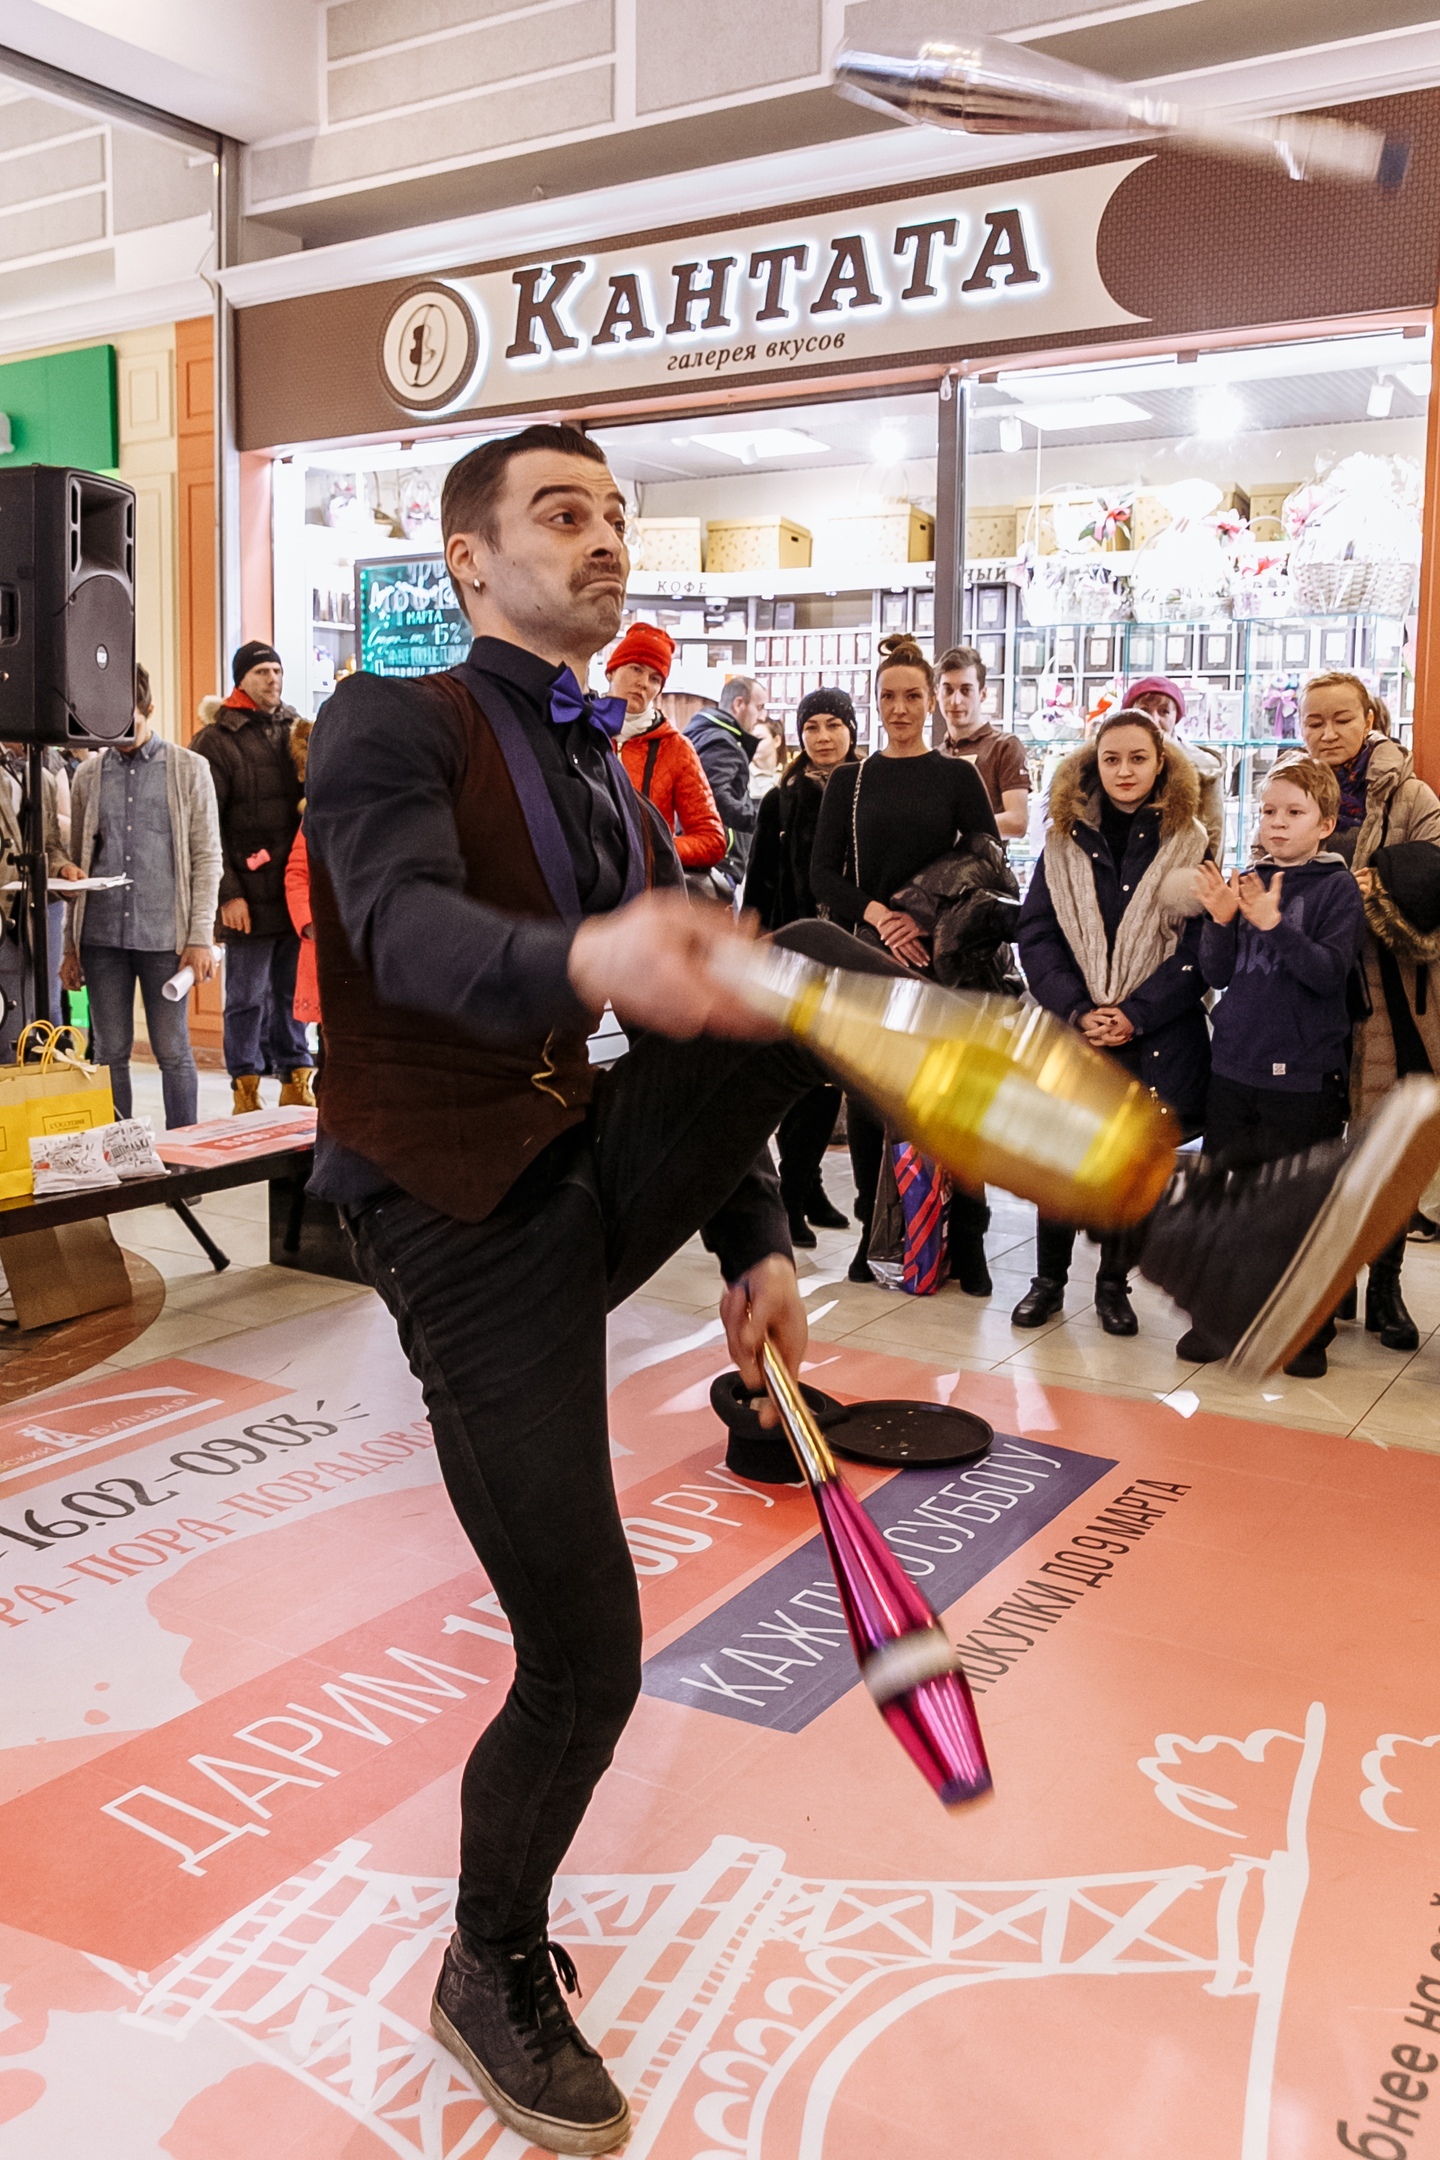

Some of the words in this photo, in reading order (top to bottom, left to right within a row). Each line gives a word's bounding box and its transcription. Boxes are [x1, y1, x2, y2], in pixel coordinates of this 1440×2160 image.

[505, 207, 1041, 360] КАНТАТА
[666, 342, 757, 373] галерея
[766, 328, 846, 367] вкусов
[656, 580, 707, 594] КОФЕ
[925, 561, 1007, 583] ЧНЫЙ
[88, 1397, 188, 1437] БУЛЬВАР
[882, 1442, 1062, 1554] СУББОТУ
[1085, 1478, 1193, 1541] МАРТА
[1071, 1535, 1130, 1555] 9
[1039, 1550, 1115, 1589] ДО
[99, 1646, 490, 1876] ДАРИМ
